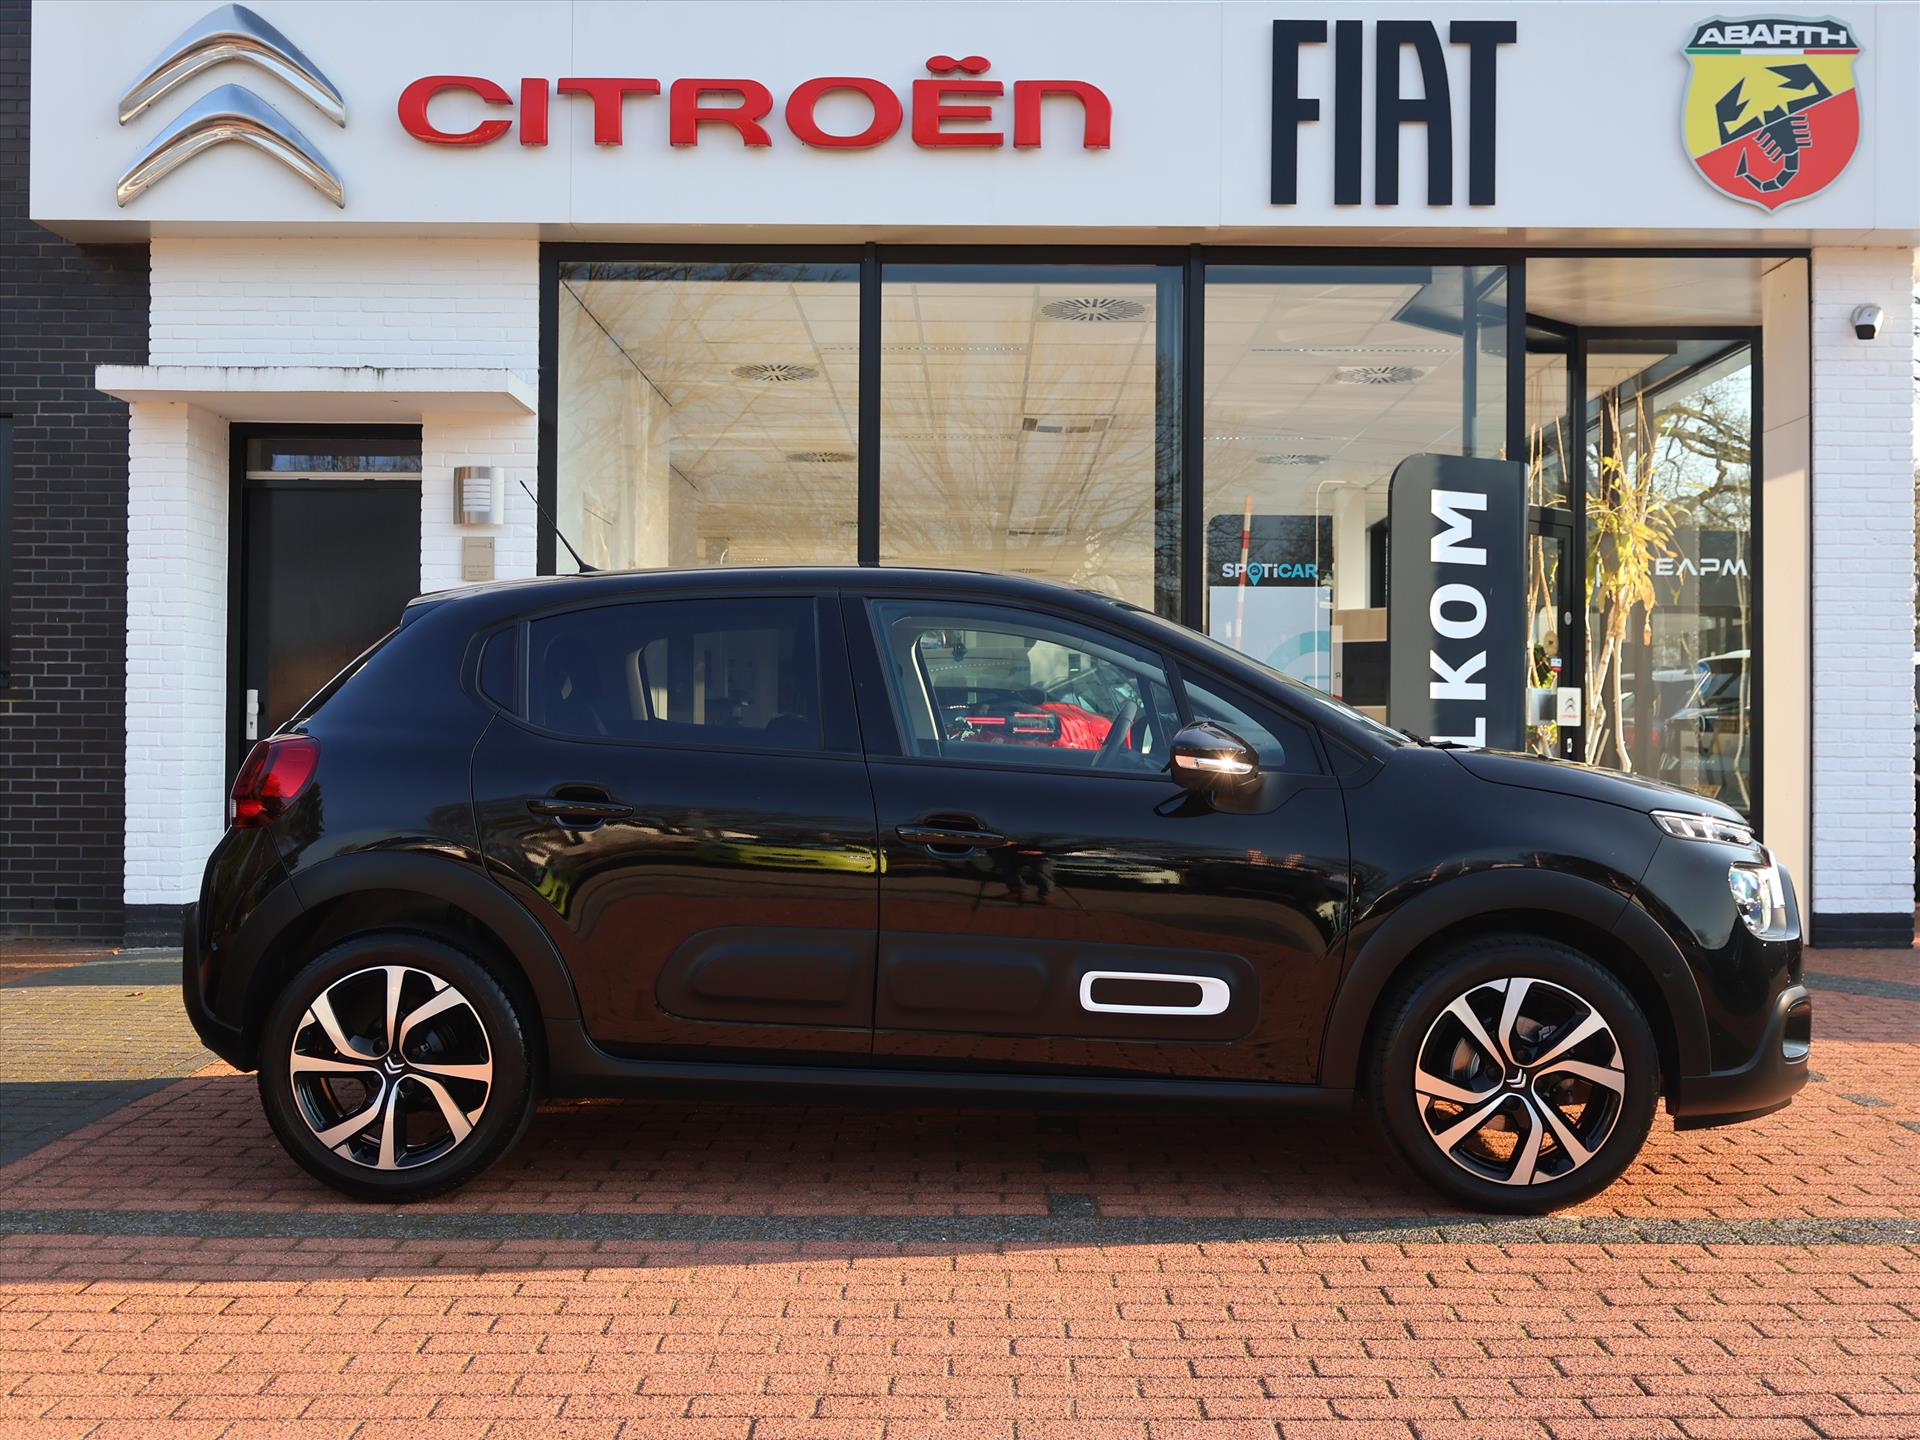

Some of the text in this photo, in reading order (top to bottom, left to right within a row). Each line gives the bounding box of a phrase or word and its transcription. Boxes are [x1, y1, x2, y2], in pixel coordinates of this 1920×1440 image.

[1697, 24, 1847, 45] ABARTH
[397, 55, 1112, 149] CITROËN
[1271, 20, 1517, 205] FIAT
